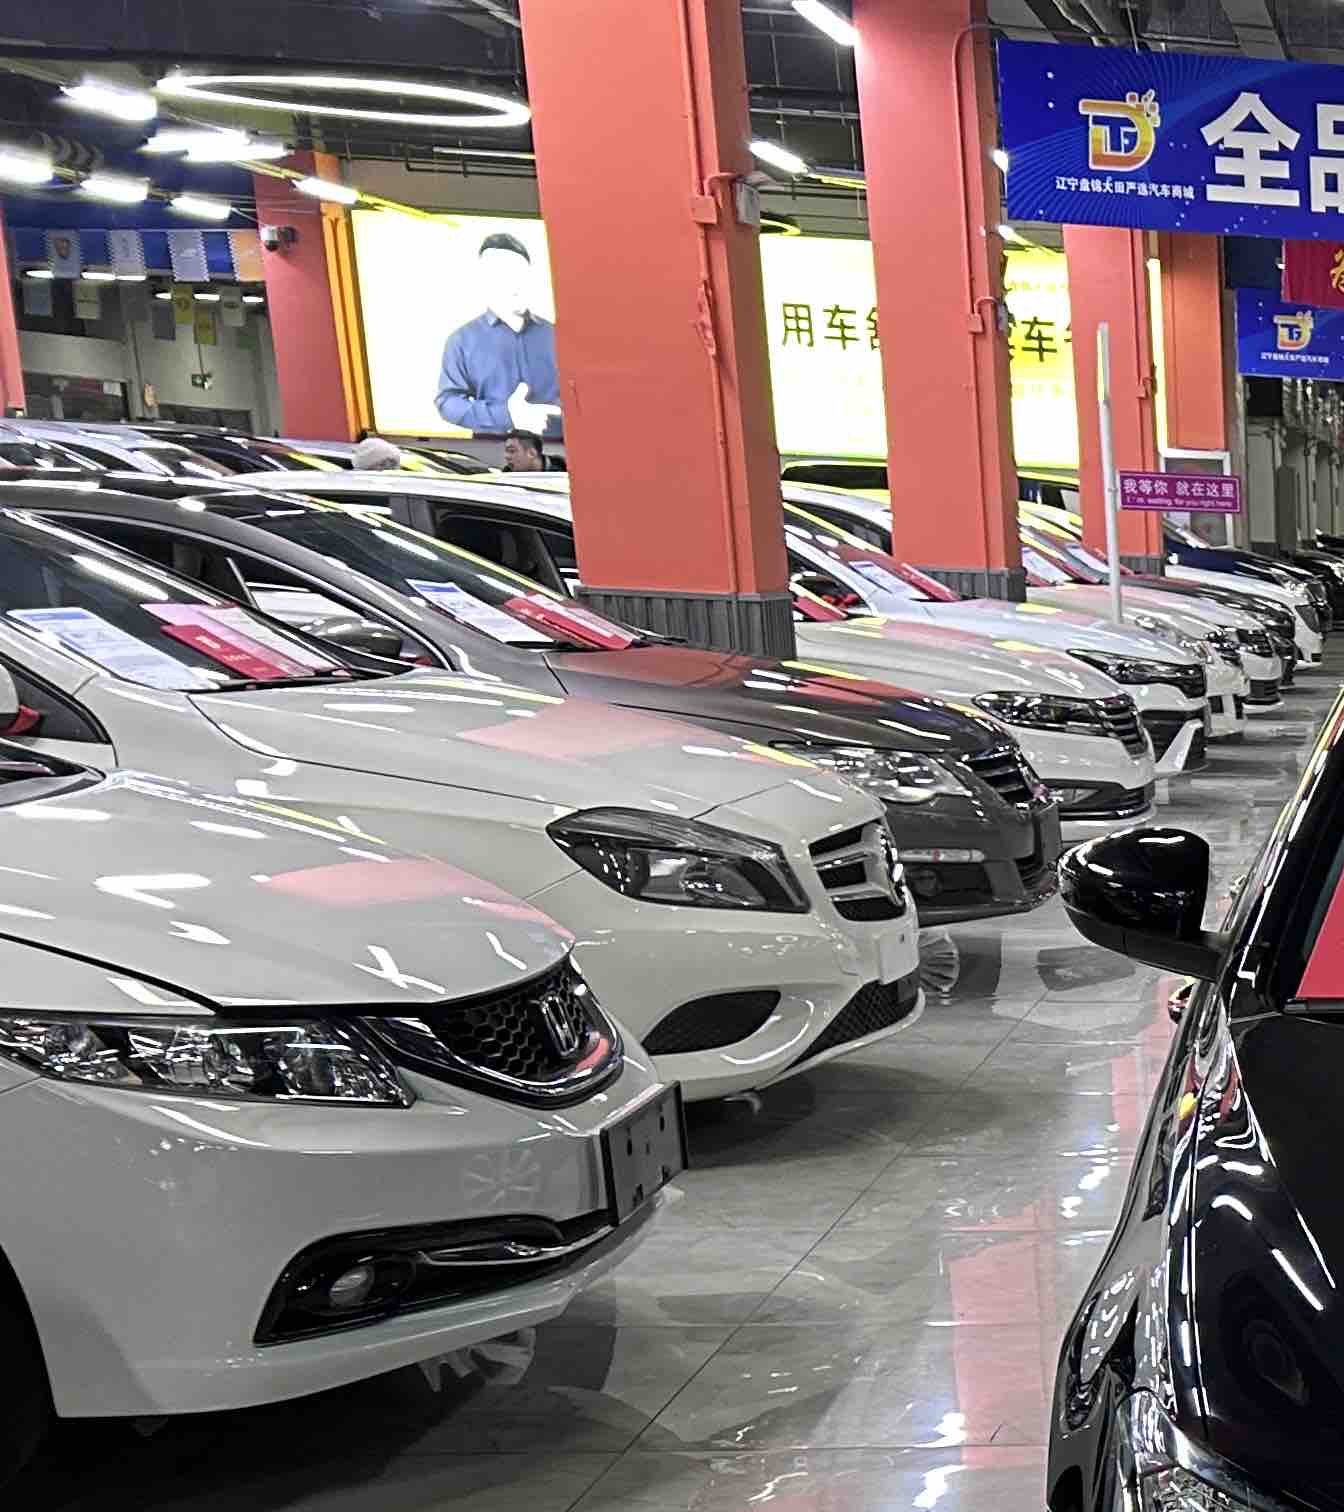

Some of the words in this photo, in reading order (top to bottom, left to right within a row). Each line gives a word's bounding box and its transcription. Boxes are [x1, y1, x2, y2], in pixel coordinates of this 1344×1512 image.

[1123, 479, 1169, 496] 我等你
[1175, 480, 1235, 498] 就在这里
